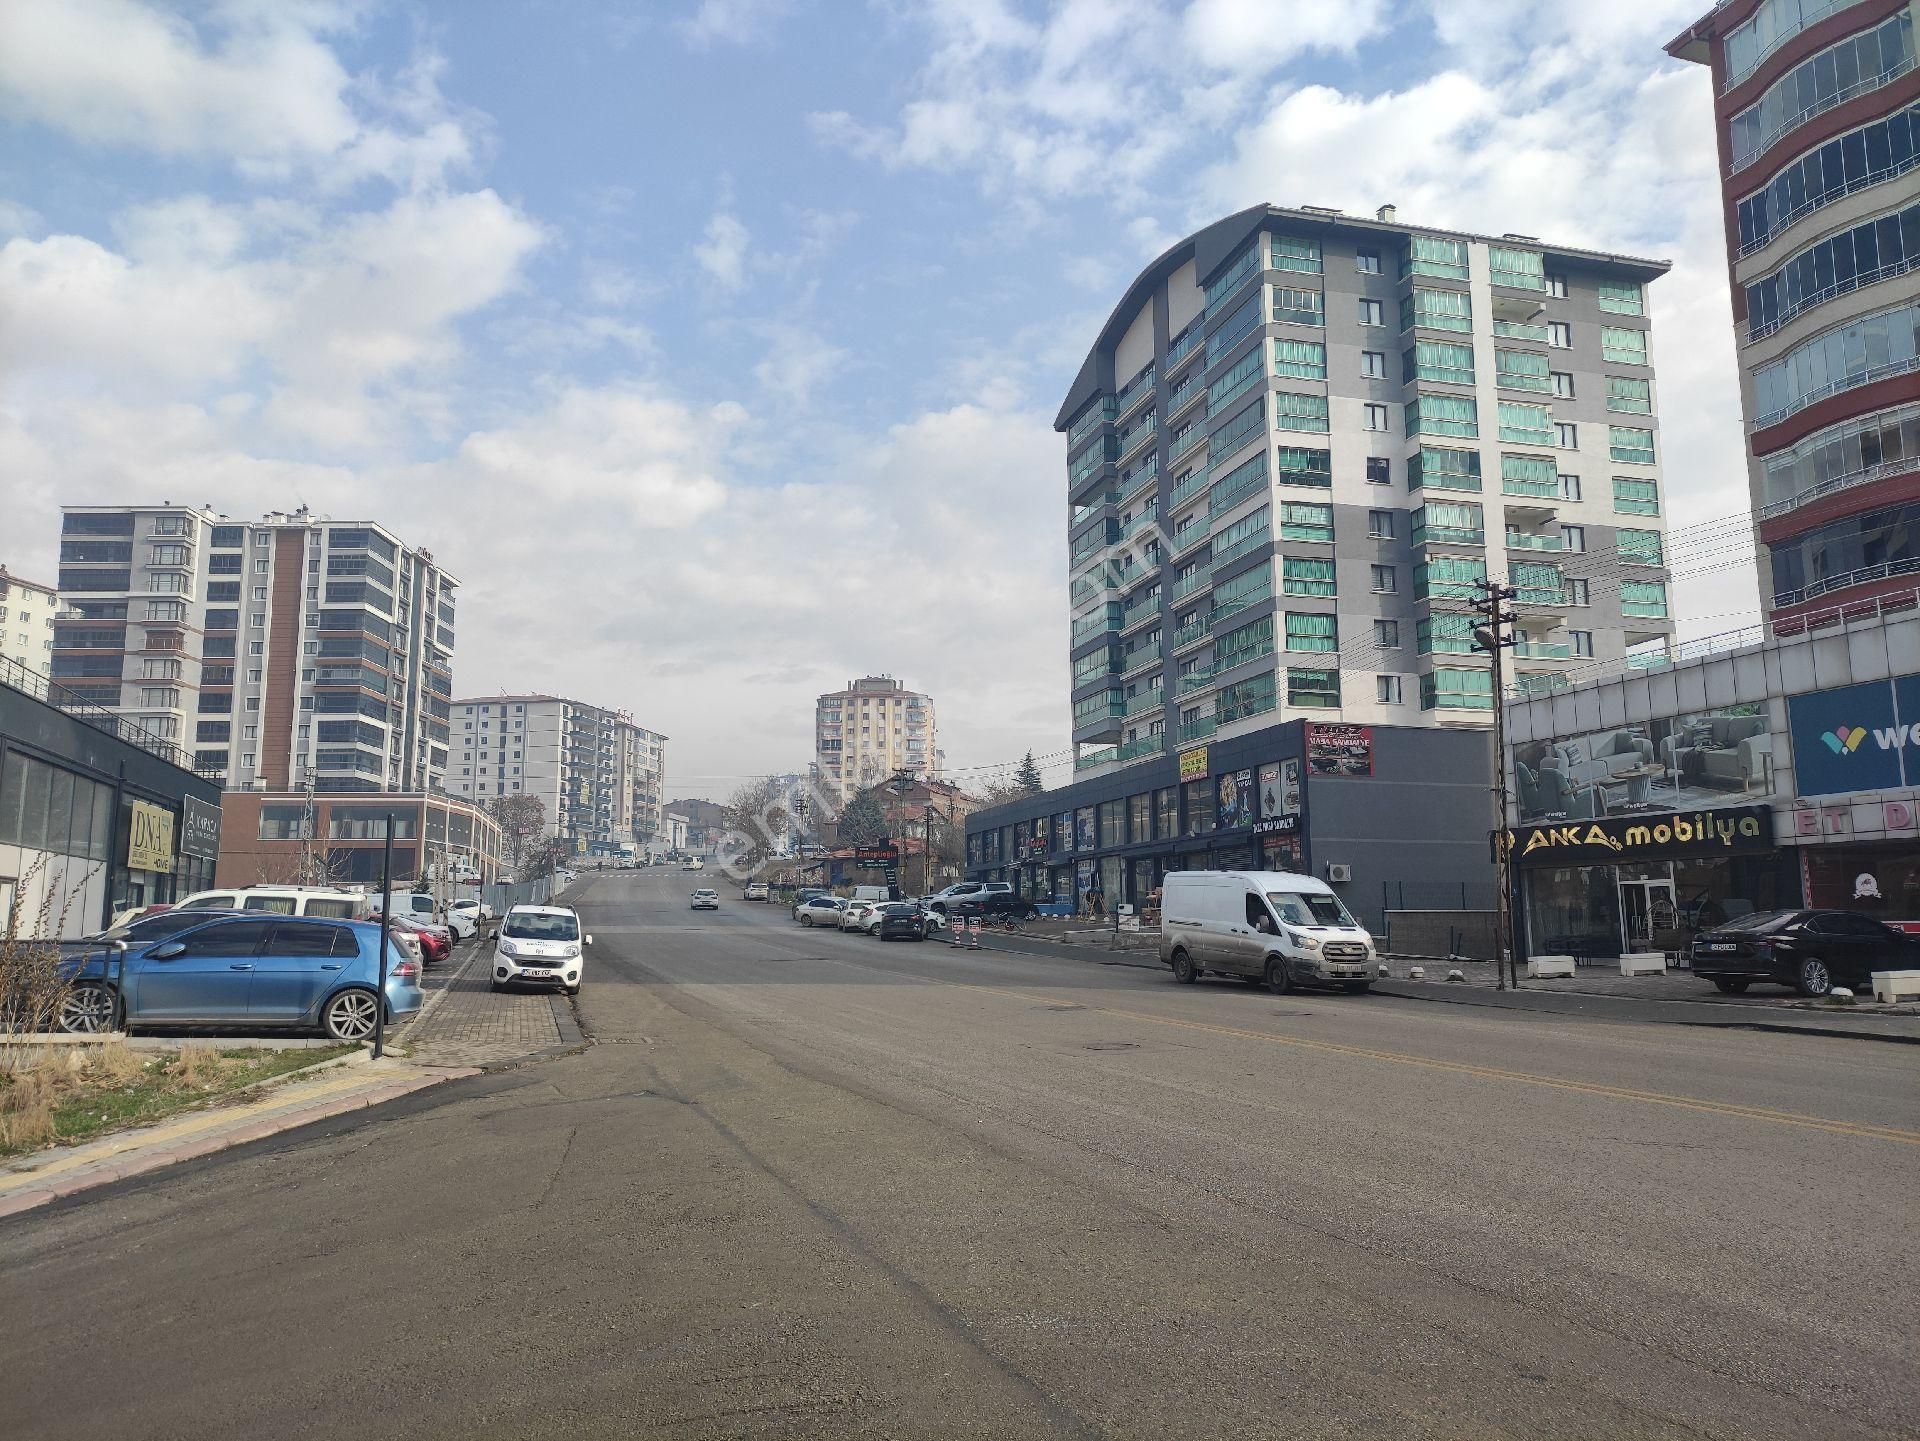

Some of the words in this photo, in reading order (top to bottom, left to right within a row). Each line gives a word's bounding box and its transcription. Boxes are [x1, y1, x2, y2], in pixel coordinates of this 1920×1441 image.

[1521, 824, 1623, 857] ANKA
[1625, 812, 1760, 846] mobilya
[1797, 807, 1850, 835] ET
